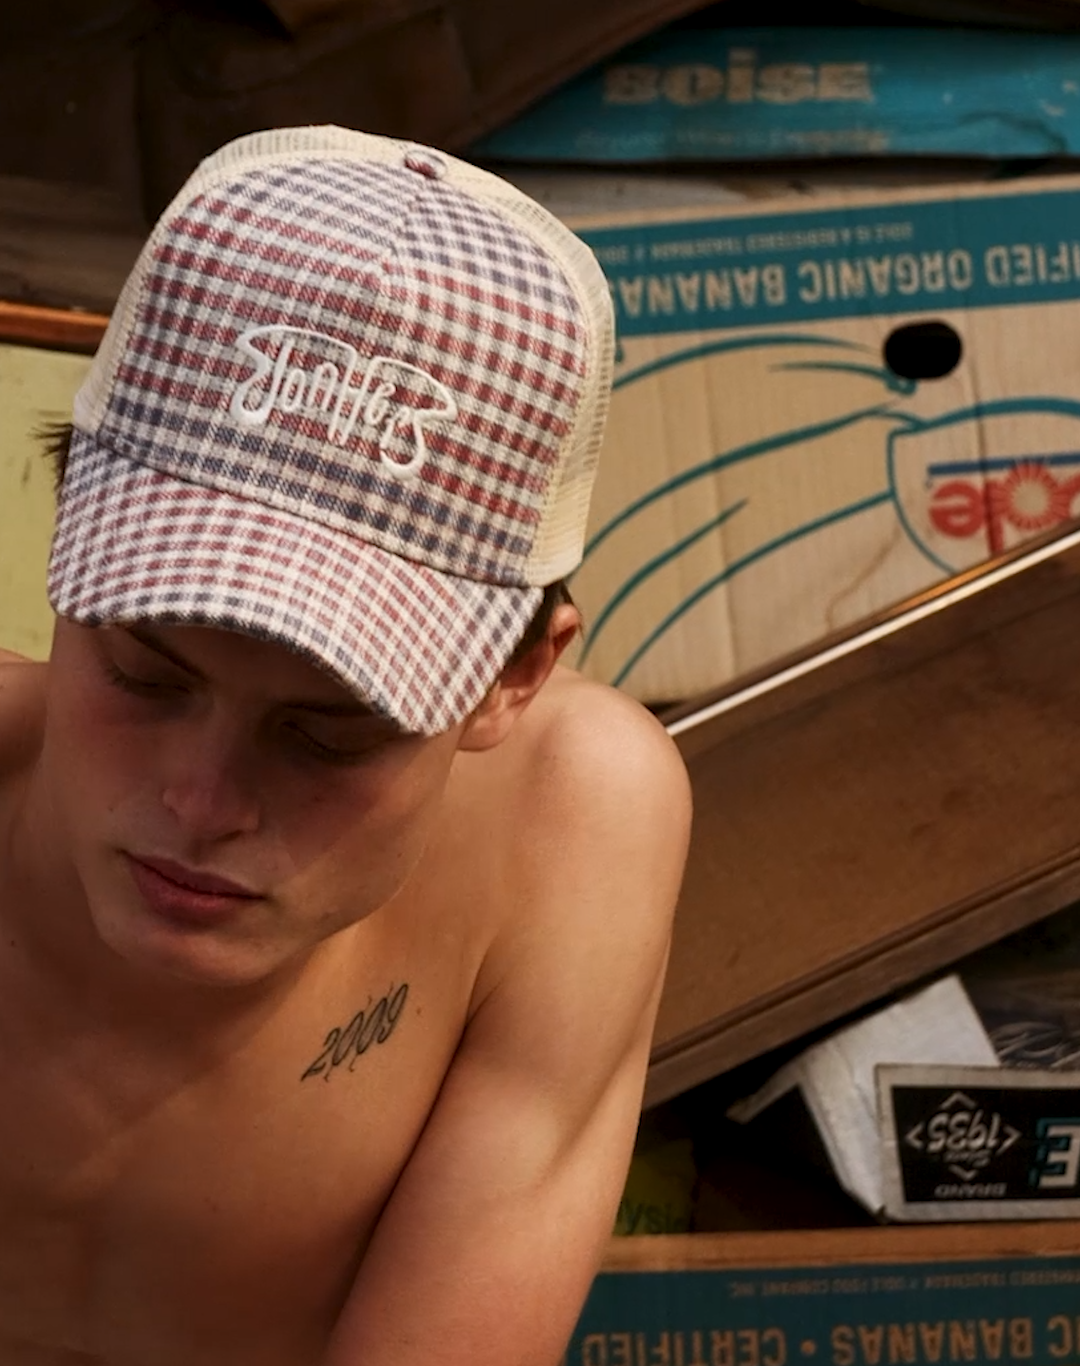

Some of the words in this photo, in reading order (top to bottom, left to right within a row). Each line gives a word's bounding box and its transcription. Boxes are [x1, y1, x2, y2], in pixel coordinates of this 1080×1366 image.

[614, 264, 787, 319] BANANA
[798, 249, 974, 304] ORGANIC
[928, 461, 1080, 556] ole
[925, 1109, 1001, 1152] 1935
[933, 1181, 1008, 1198] BRAND
